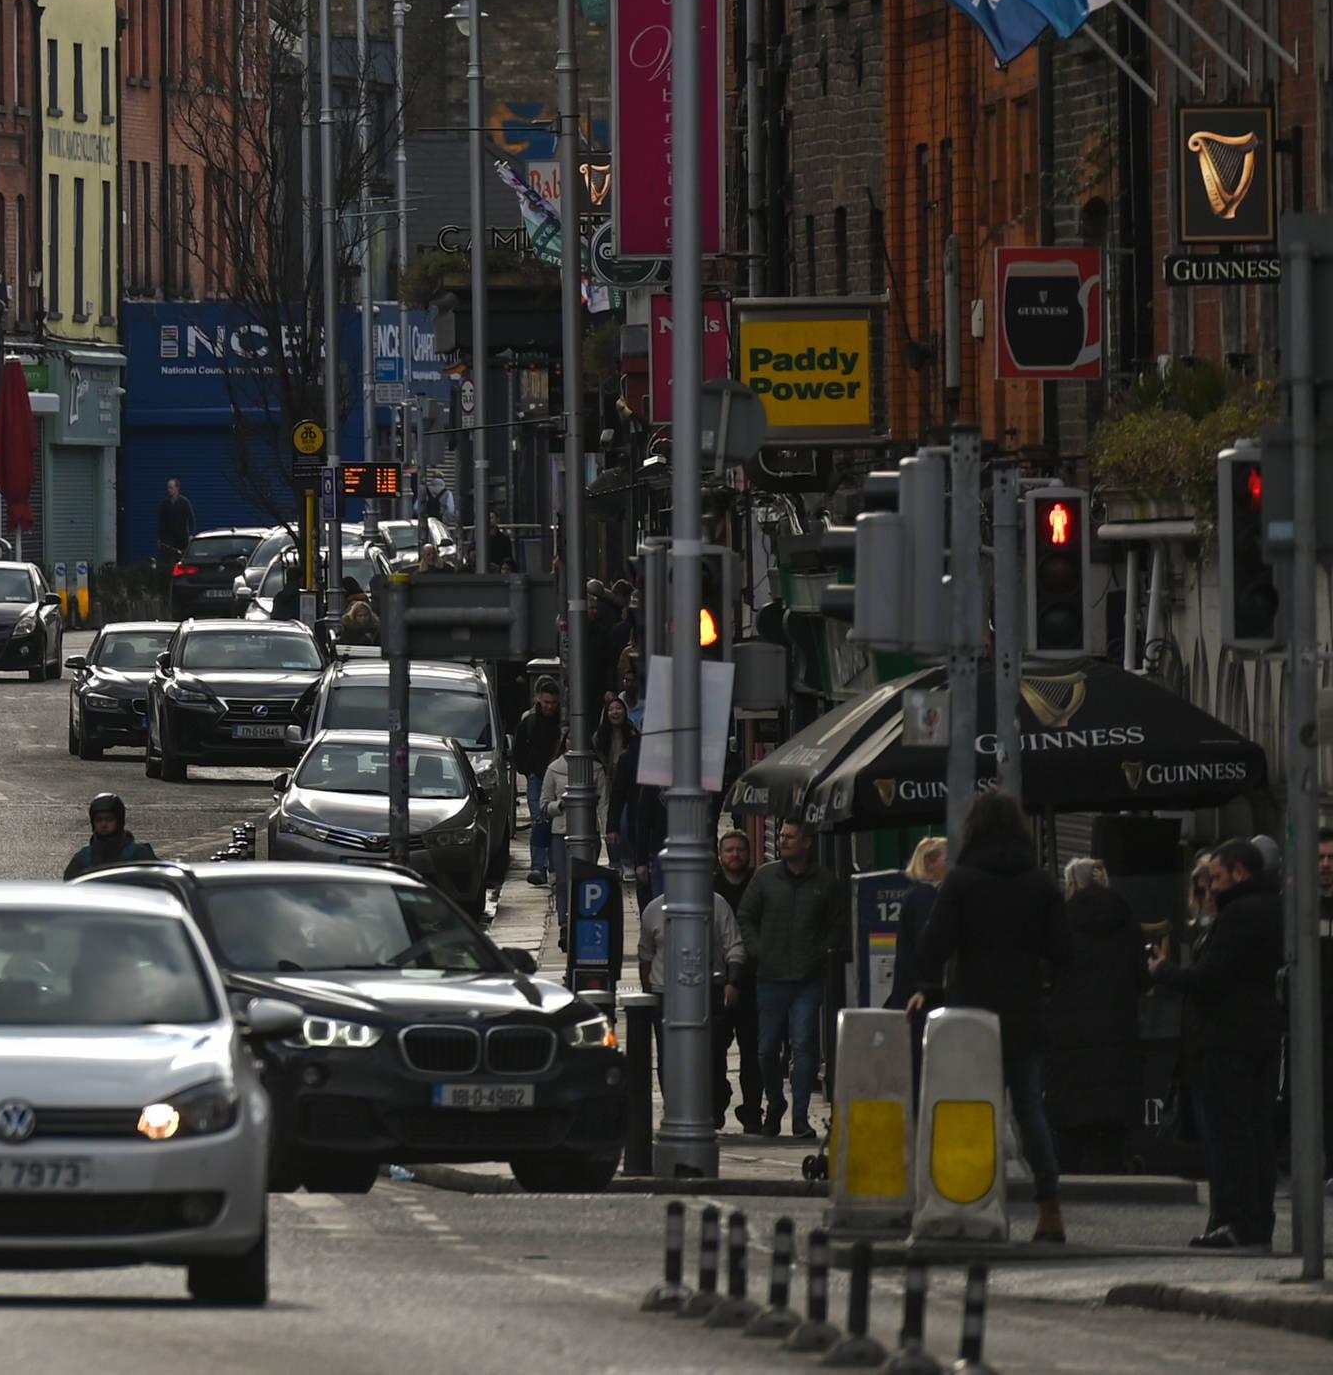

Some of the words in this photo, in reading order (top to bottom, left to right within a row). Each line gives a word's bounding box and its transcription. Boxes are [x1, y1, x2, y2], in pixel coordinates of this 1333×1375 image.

[1173, 259, 1281, 281] GUINNESS
[1017, 307, 1069, 315] GUINNESS
[659, 316, 720, 333] Nls
[161, 366, 197, 374] National
[749, 347, 860, 375] Paddy
[749, 377, 861, 401] Power
[1146, 762, 1246, 784] GUINNESS
[581, 883, 603, 914] P
[876, 901, 902, 922] 12
[12, 1160, 82, 1187] 7973
